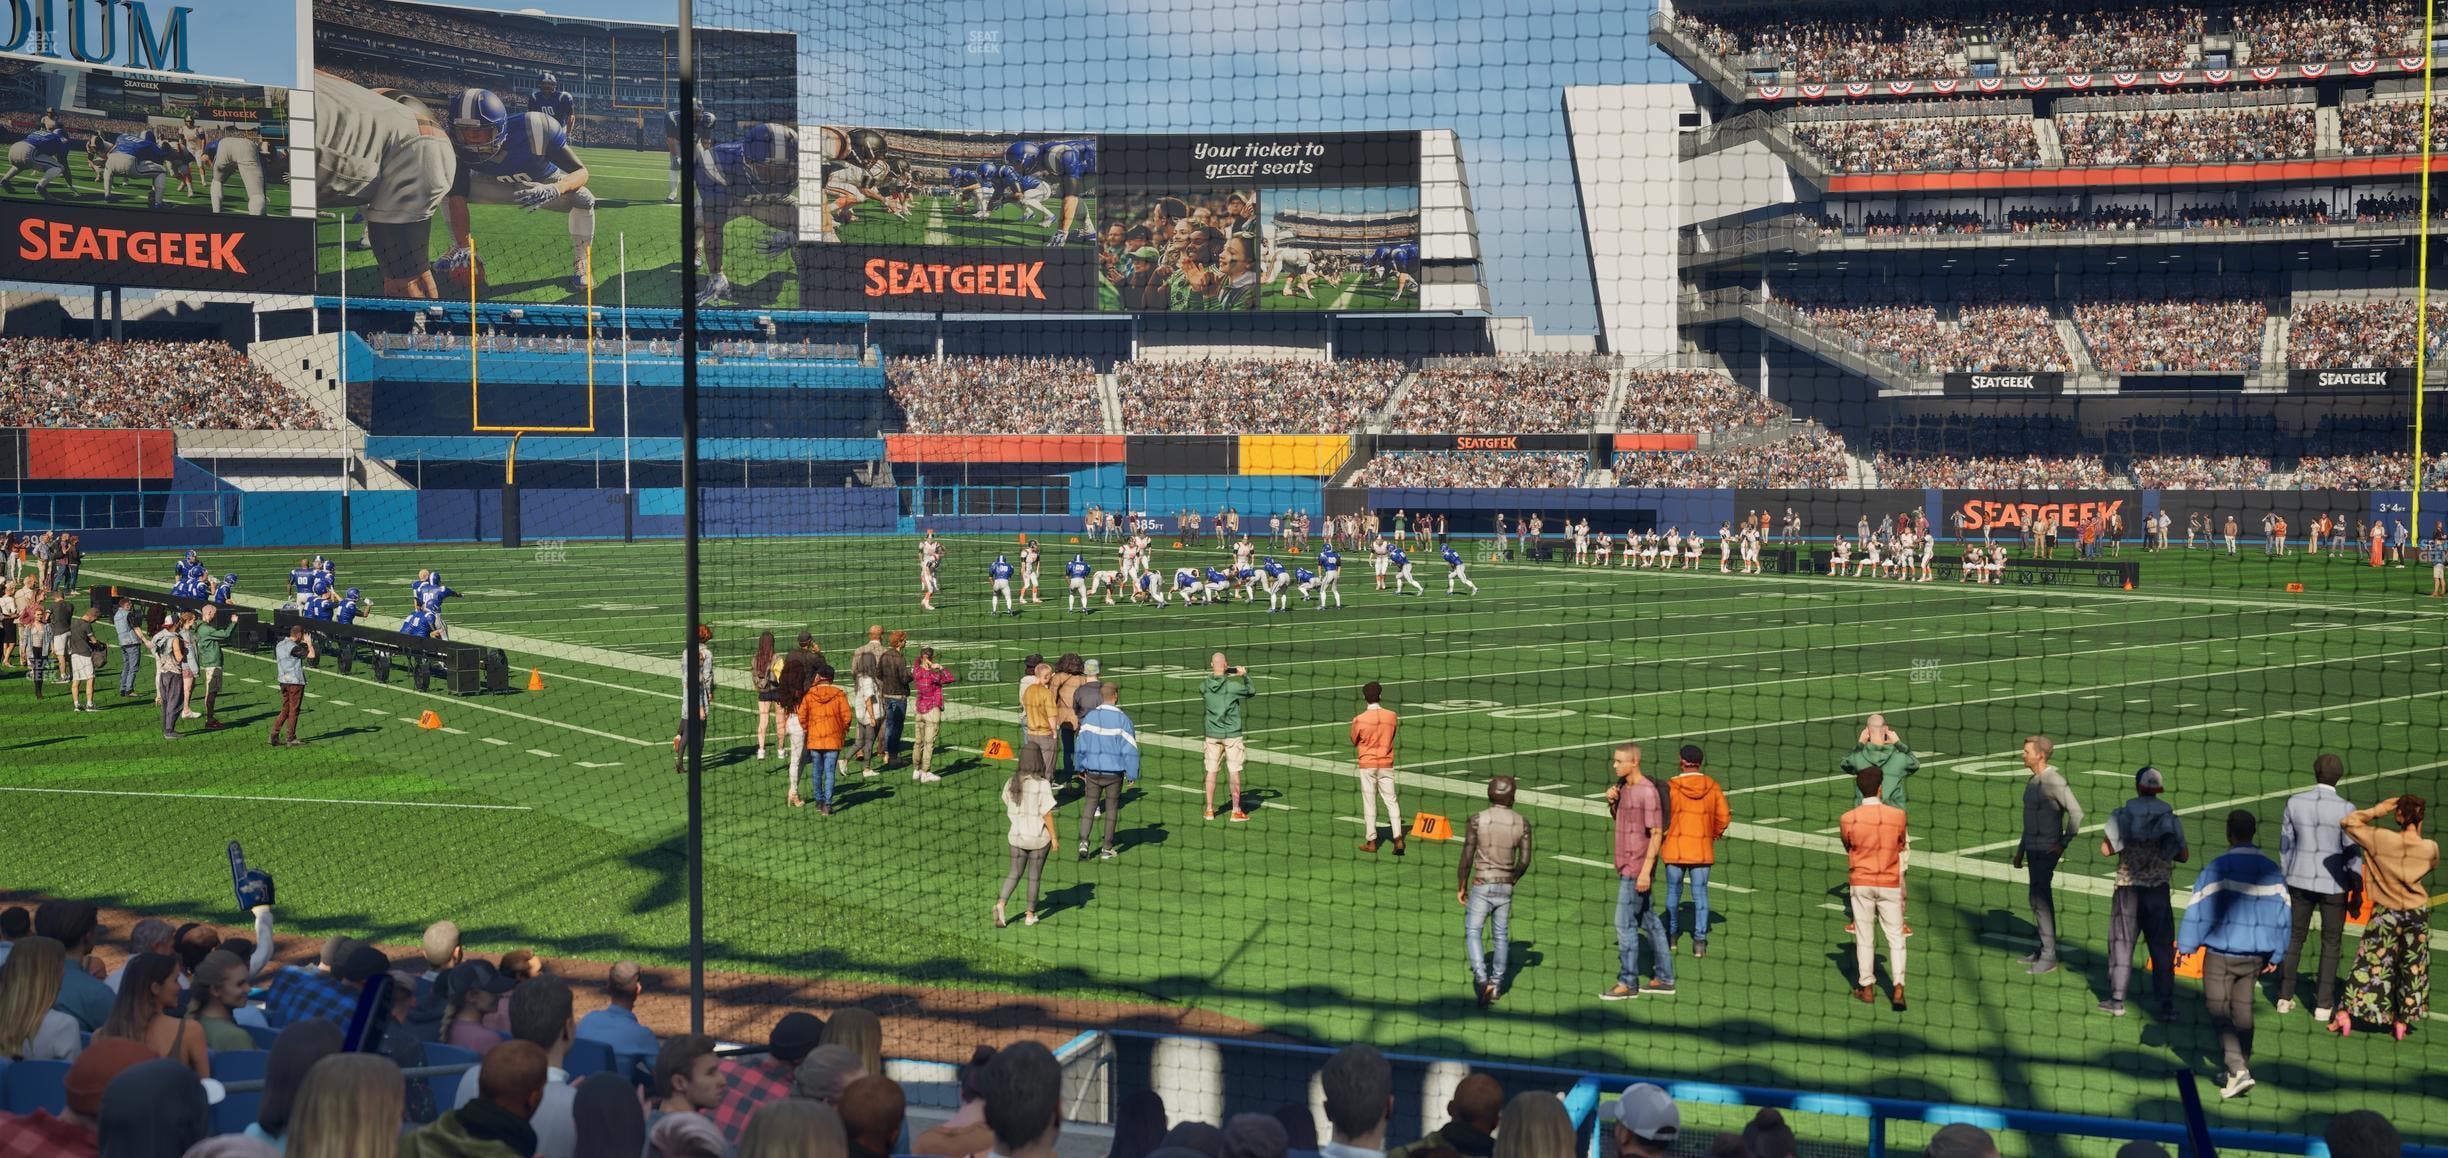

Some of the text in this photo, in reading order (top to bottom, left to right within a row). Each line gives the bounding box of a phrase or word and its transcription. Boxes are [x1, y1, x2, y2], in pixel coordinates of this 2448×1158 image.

[124, 80, 160, 90] SEATGEEK
[212, 109, 258, 119] SEATGEEK
[1194, 142, 1325, 160] Your ticket to
[1205, 160, 1314, 179] great seats
[19, 218, 248, 275] SEATGEEK
[864, 258, 1047, 300] SEATGEEK
[1971, 375, 2035, 389] SEATGEEK
[2318, 371, 2388, 386] SEATGEEK
[1457, 436, 1518, 450] SEATGEEK
[1963, 500, 2124, 530] SEATGEEK
[297, 577, 308, 585] 00
[989, 741, 1001, 755] 20
[1421, 817, 1436, 834] 10
